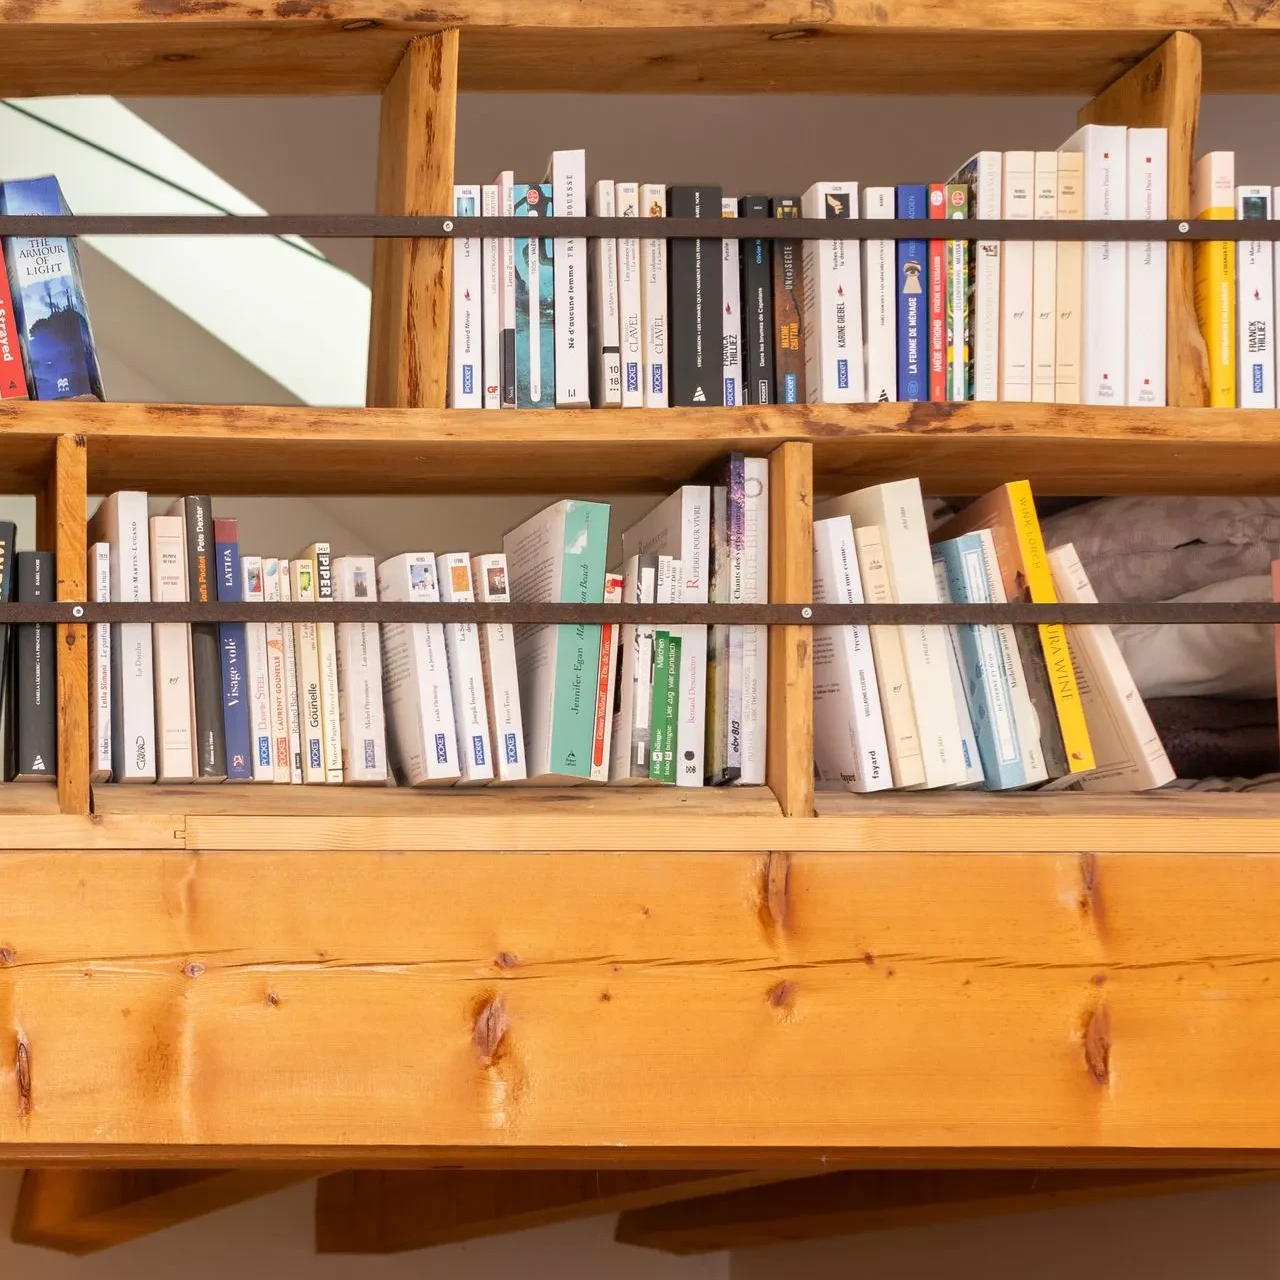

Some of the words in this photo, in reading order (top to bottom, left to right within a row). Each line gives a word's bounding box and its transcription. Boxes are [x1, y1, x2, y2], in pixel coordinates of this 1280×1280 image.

[19, 244, 65, 259] ARMOUR
[28, 237, 50, 248] THE
[26, 263, 63, 276] LIGHT
[36, 257, 50, 266] OF
[567, 296, 575, 335] d'aucune
[837, 302, 845, 324] GIEBEL
[907, 297, 917, 326] MÉNAGE
[567, 337, 574, 348] Né
[629, 314, 639, 352] CLAVEL
[654, 315, 664, 354] CLAVEL
[781, 325, 789, 348] MAXIME
[838, 325, 846, 348] KARINE
[909, 327, 916, 336] DE
[933, 320, 941, 350] NOTHOMB
[1248, 321, 1256, 352] FRANCK
[1257, 321, 1266, 352] THILLIEZ
[729, 335, 738, 365] THILLIEZ
[909, 338, 917, 362] FEMME
[463, 365, 472, 393] POCKET
[627, 362, 637, 391] POCKET
[652, 364, 662, 393] POCKET
[839, 360, 847, 388] POCKET
[909, 364, 916, 373] LA
[1253, 365, 1262, 392] POCKET
[487, 385, 498, 394] GF
[726, 378, 734, 405] POCKET
[195, 506, 204, 532] Dexter
[1019, 497, 1032, 530] WINK
[196, 534, 205, 551] Pete
[685, 552, 700, 589] REPÈRES
[693, 505, 701, 527] VIVRE
[1025, 531, 1041, 569] LORCH
[197, 555, 207, 583] Pocket
[223, 549, 233, 586] LATIFA
[319, 557, 332, 597] PIPER
[579, 564, 589, 590] Beach
[843, 571, 851, 586] une
[733, 572, 742, 599] Chants
[101, 624, 109, 649] parfum
[1000, 633, 1011, 651] avant
[225, 638, 237, 663] volé
[573, 647, 584, 671] Egan
[656, 638, 664, 668] Märchen
[274, 656, 282, 693] GOUNELLE
[1005, 652, 1018, 688] Madelaine
[1057, 656, 1075, 702] WINE
[225, 666, 240, 706] Visage
[255, 675, 265, 700] STEEL
[289, 690, 297, 708] Bach
[571, 675, 582, 715] Jennifer
[308, 683, 319, 727] Gounelle
[471, 706, 480, 725] Joseph
[687, 697, 695, 724] Bernard
[290, 709, 299, 733] Richard
[329, 719, 337, 741] Pagnol
[101, 738, 109, 755] folio
[259, 737, 269, 766] POCKET
[278, 737, 287, 766] POCKET
[310, 739, 319, 768] POCKET
[330, 743, 338, 765] Marcel
[435, 734, 447, 763] POCKET
[473, 736, 484, 765] POCKET
[507, 733, 517, 763] POCKET
[654, 729, 662, 752] bilingue
[868, 750, 880, 779] fayard
